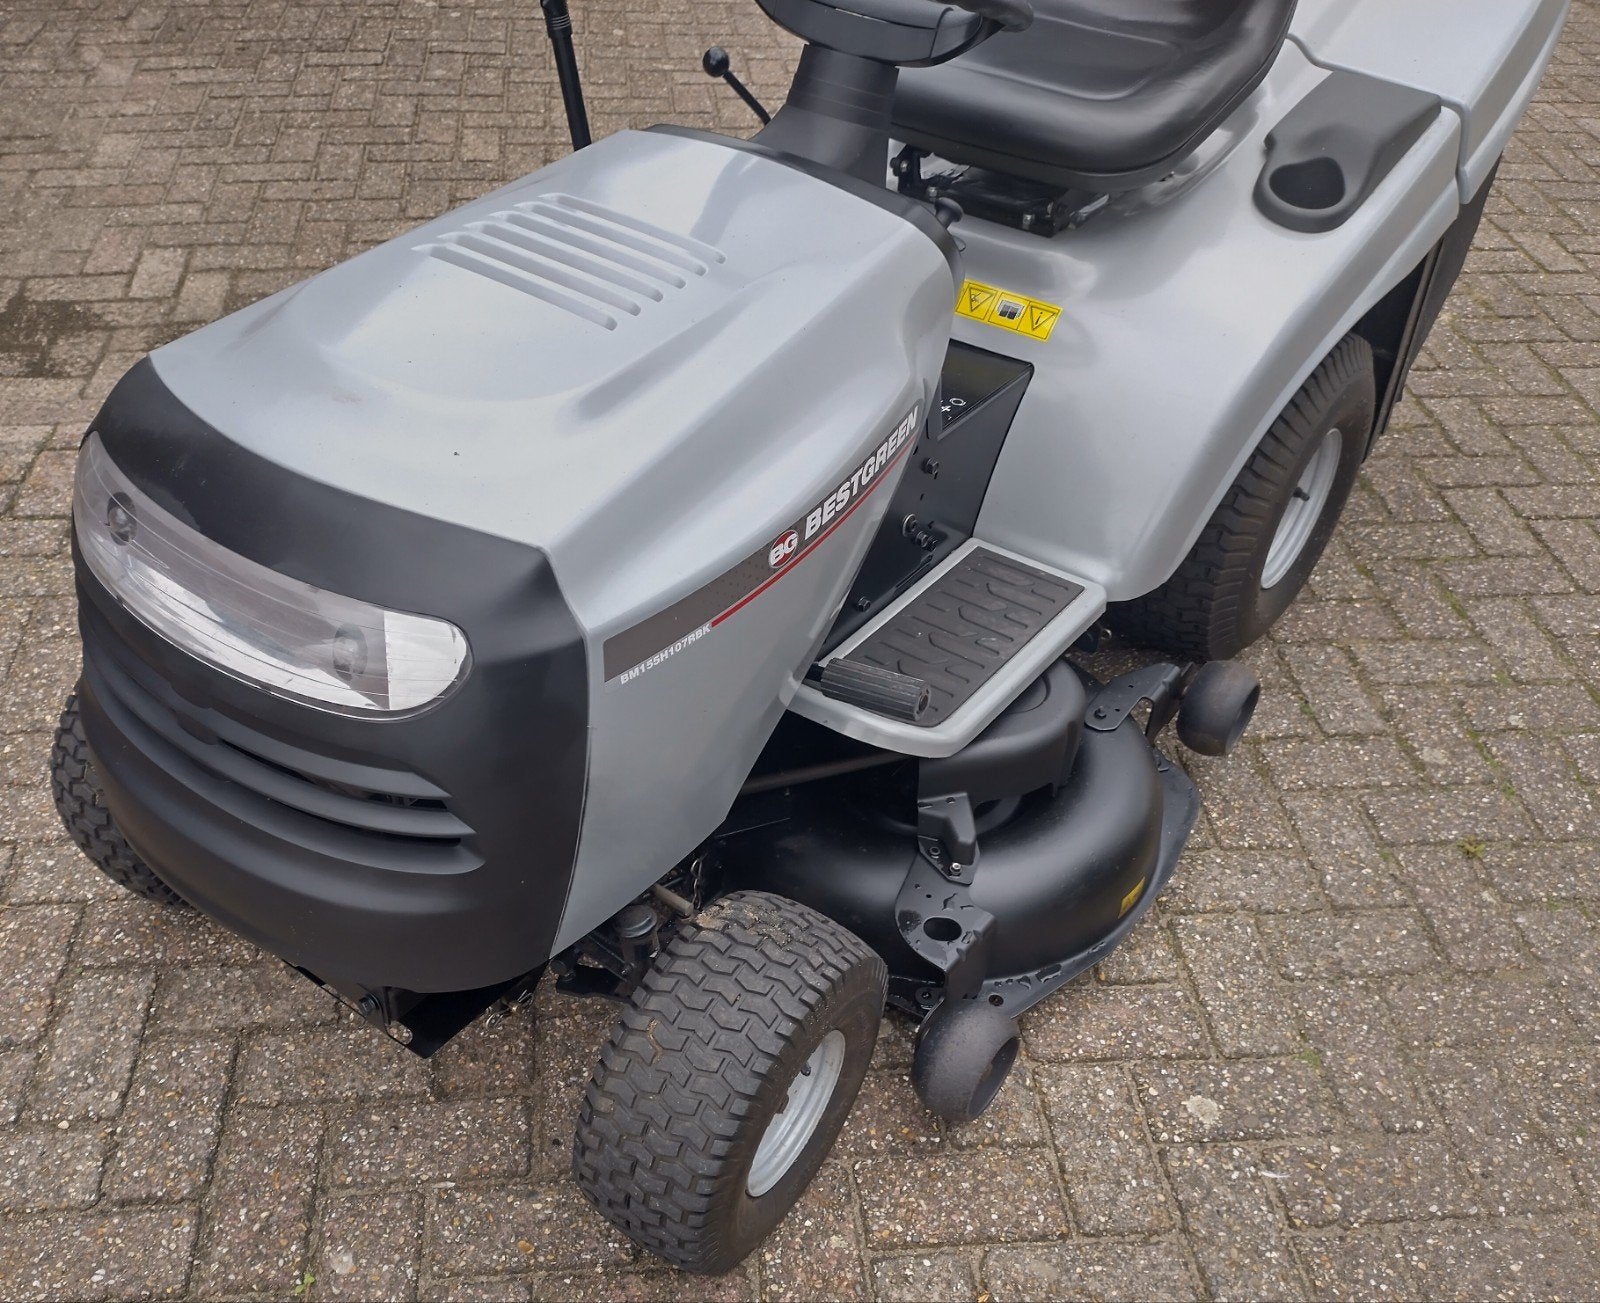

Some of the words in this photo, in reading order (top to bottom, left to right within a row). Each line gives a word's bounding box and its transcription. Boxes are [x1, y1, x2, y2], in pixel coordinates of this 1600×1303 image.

[769, 532, 798, 567] BG
[804, 405, 919, 540] BESTGREEN
[620, 623, 711, 685] BM155H107RBK
